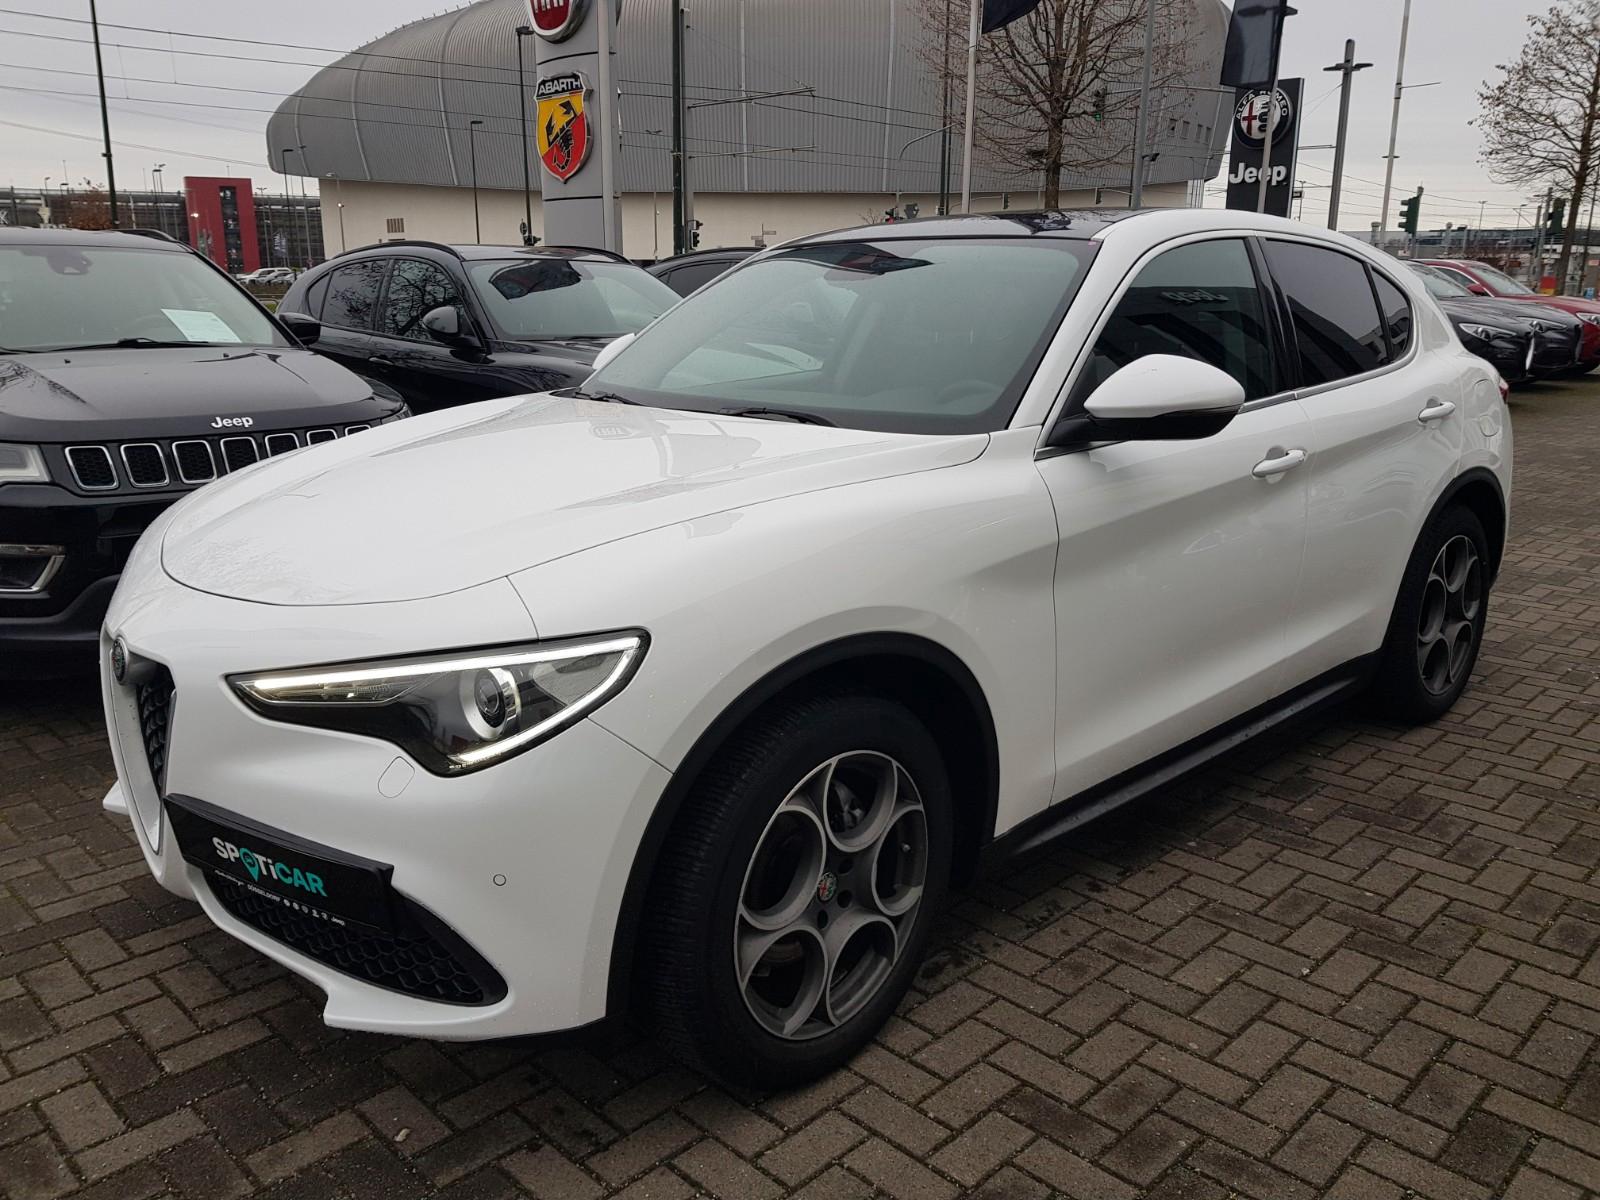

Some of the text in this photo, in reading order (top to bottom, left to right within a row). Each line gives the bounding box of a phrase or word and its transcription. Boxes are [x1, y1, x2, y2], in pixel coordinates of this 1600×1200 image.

[538, 78, 582, 95] ABARTH
[1236, 91, 1287, 119] ALFA RMEO
[210, 416, 253, 428] Jeep
